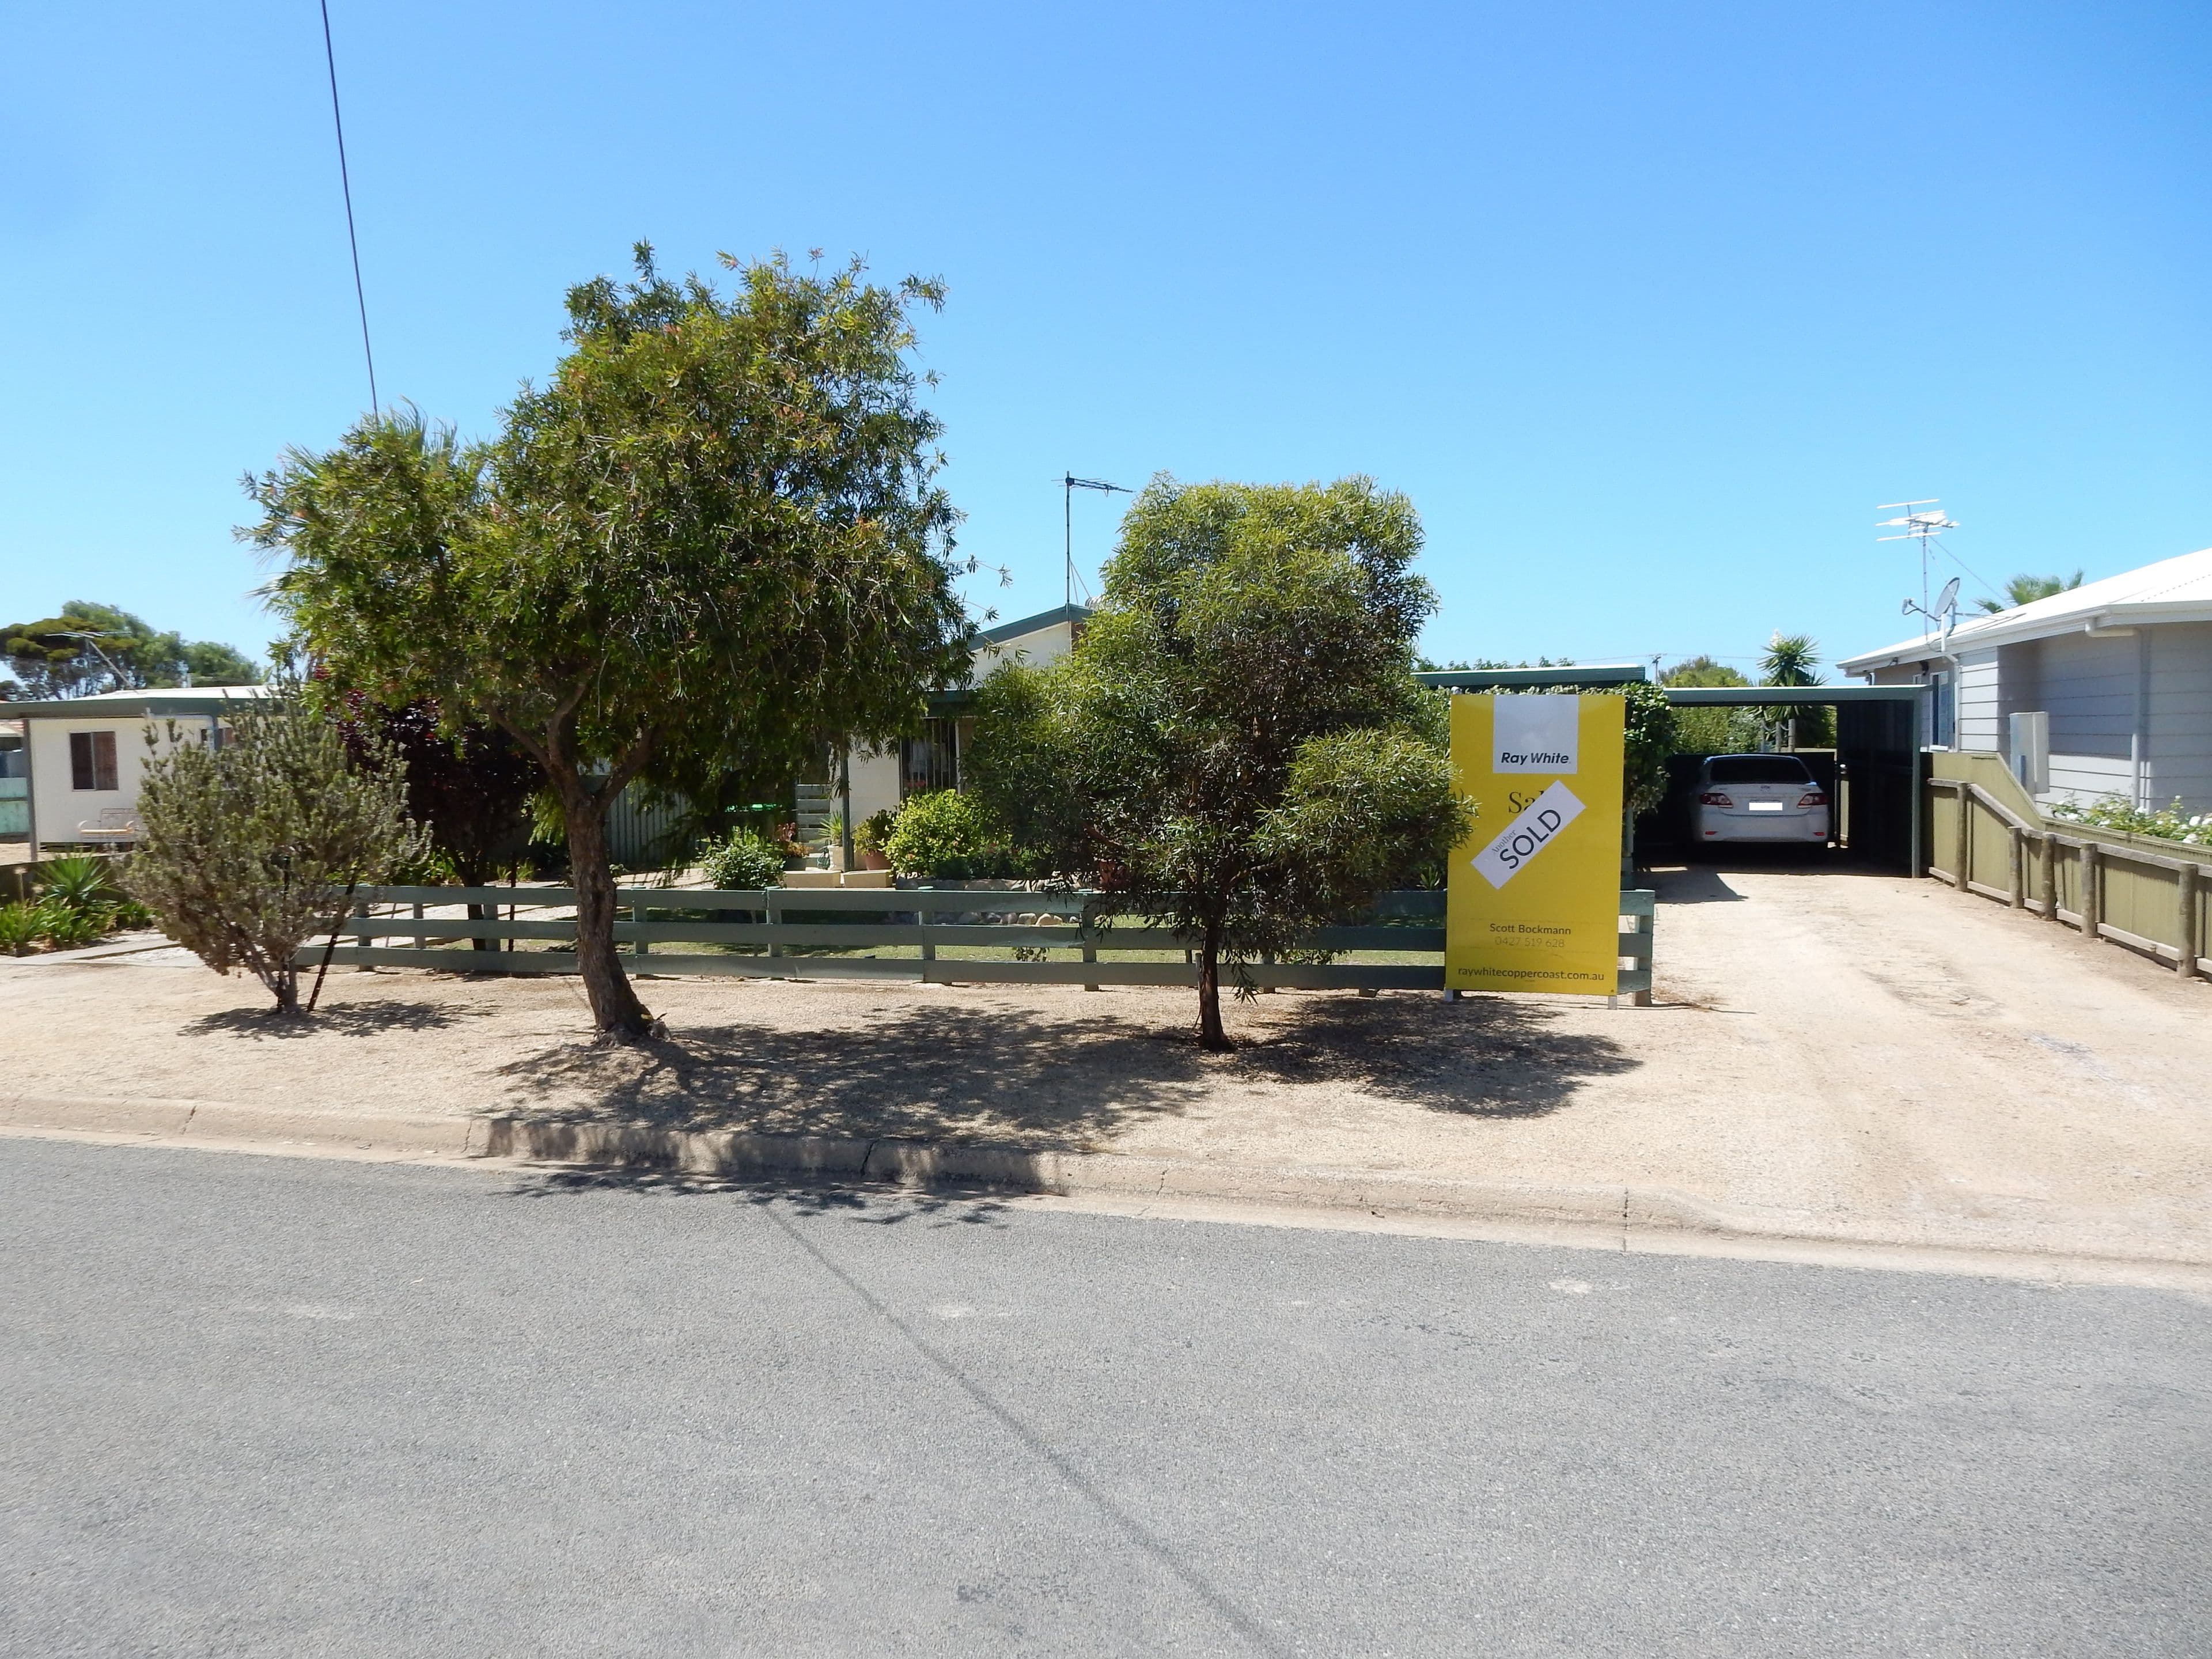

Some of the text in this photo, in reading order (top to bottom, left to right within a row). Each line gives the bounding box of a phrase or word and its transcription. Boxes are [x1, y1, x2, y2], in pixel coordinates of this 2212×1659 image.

[1501, 752, 1569, 765] Ray White
[1491, 830, 1517, 854] Another
[1499, 809, 1561, 869] SOLD
[1490, 923, 1571, 935] Scott Bockmann
[1495, 936, 1521, 946] 0427
[1458, 967, 1604, 981] raywhitecoppercoast.com.au
